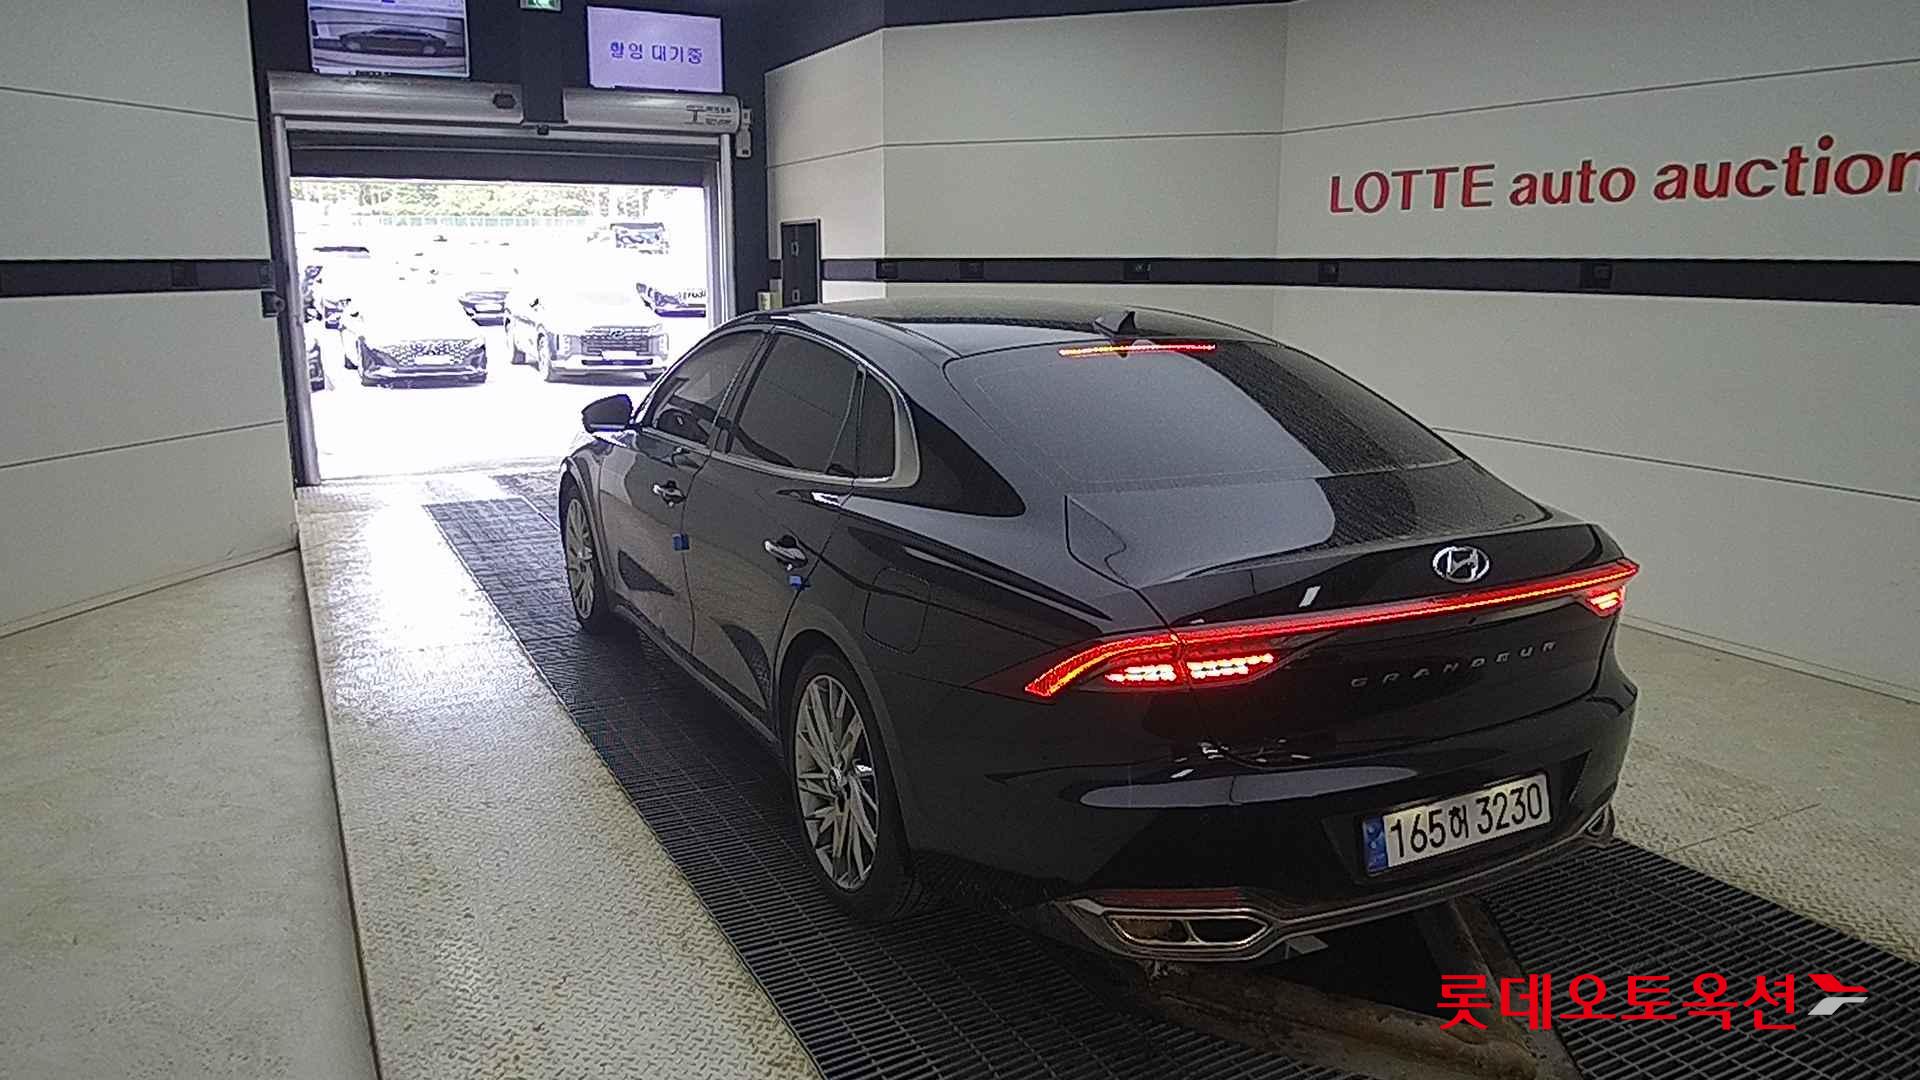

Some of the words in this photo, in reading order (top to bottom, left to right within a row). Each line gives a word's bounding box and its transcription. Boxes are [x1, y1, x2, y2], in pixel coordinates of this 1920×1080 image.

[652, 44, 702, 65] 대기중
[1330, 164, 1495, 214] LOTTE
[1510, 160, 1636, 206] auto
[1351, 641, 1556, 688] GRANDEUR
[1391, 805, 1470, 859] 165허
[1476, 782, 1543, 834] 3230
